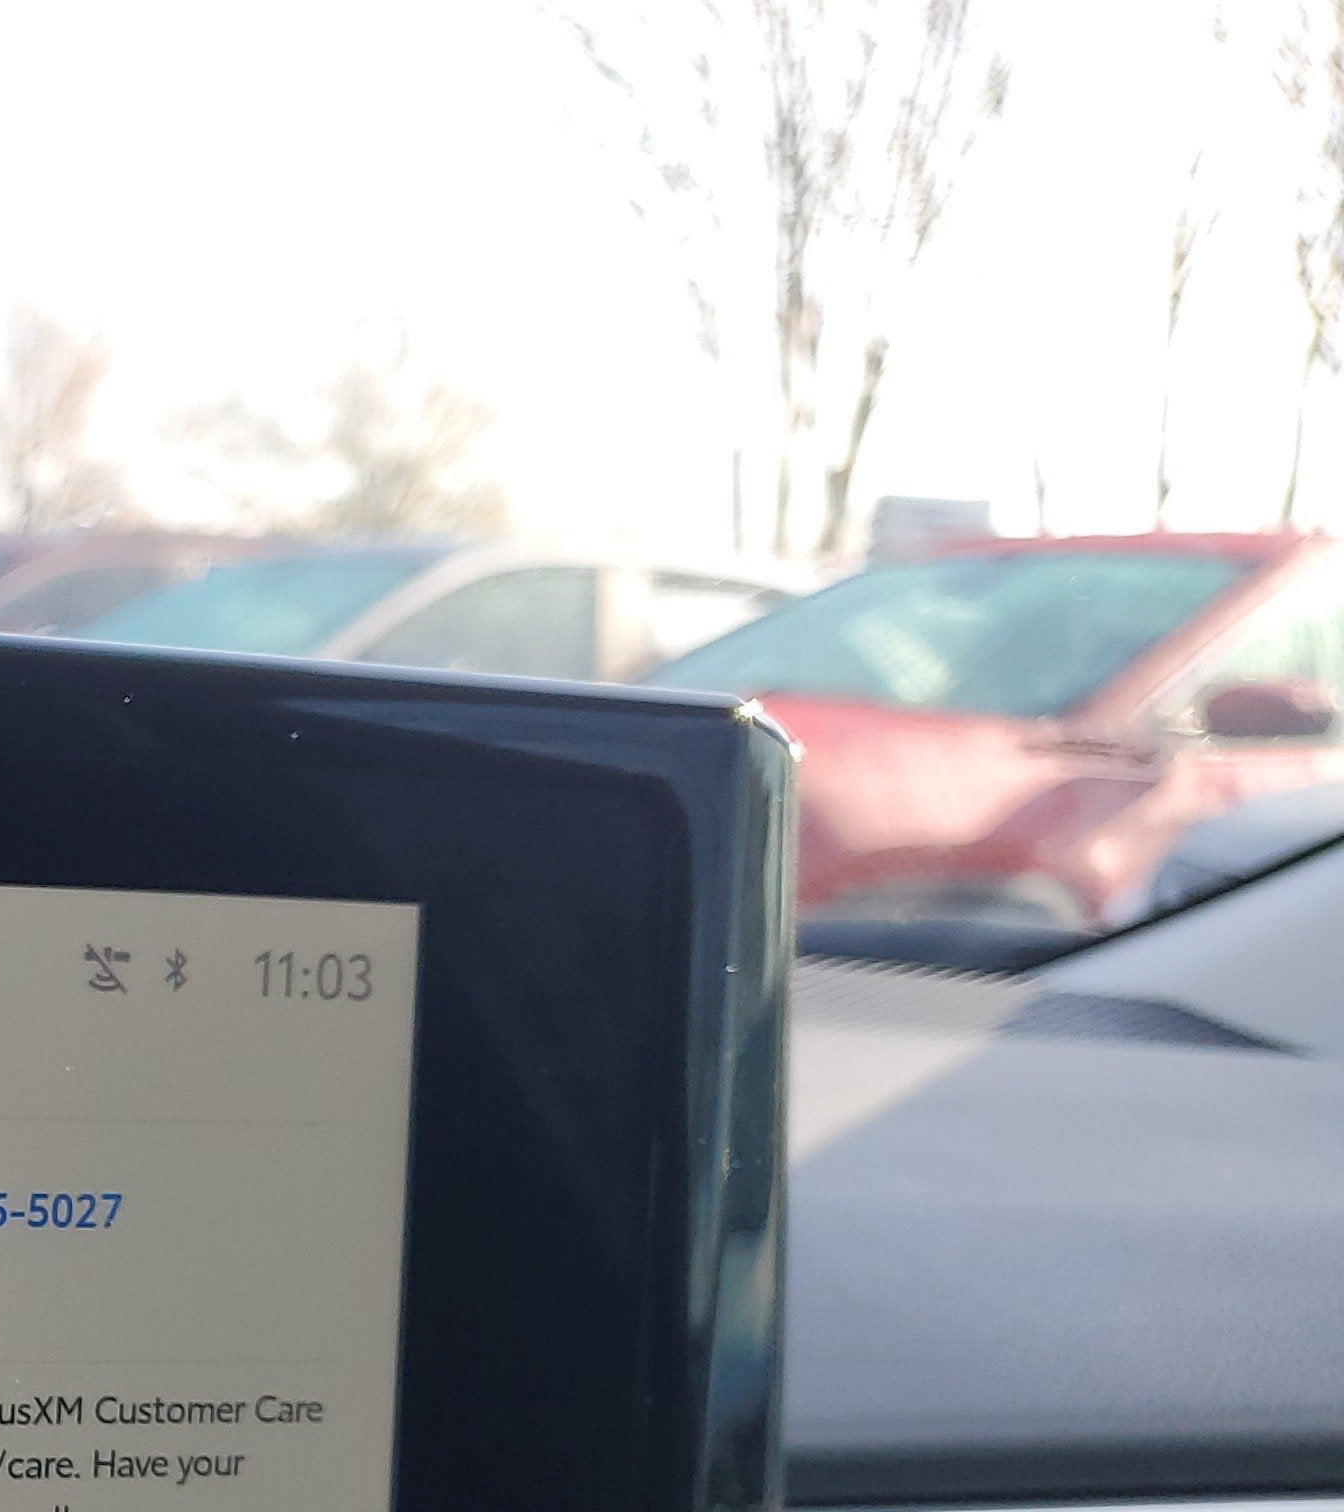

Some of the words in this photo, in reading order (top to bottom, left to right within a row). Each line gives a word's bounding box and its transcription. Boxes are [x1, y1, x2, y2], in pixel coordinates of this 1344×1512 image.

[254, 950, 373, 1003] 11:03
[94, 1395, 247, 1425] Customer
[254, 1394, 324, 1424] Care
[93, 1449, 169, 1479] Have
[175, 1455, 246, 1486] your
